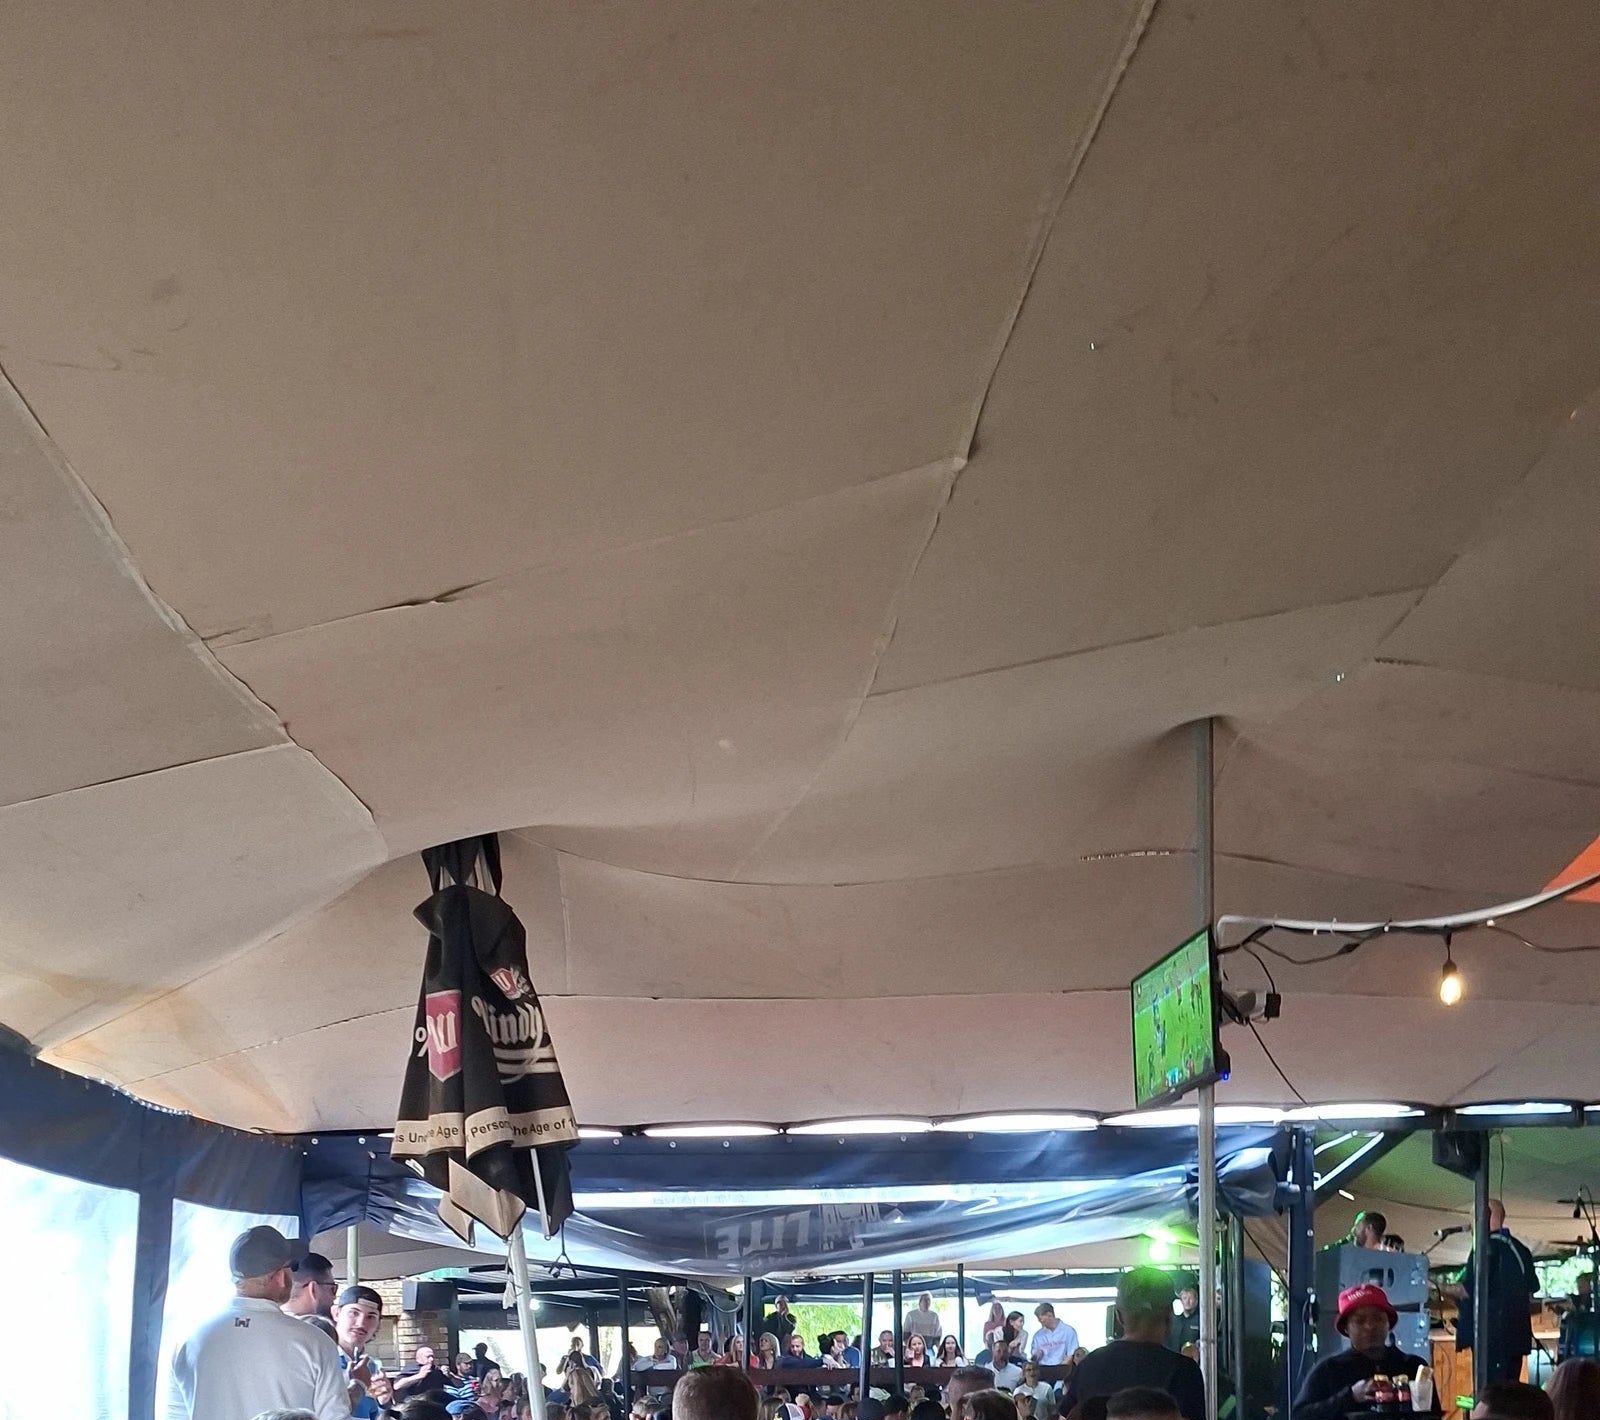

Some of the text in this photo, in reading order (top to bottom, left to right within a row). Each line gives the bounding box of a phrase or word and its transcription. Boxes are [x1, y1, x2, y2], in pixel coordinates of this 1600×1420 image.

[436, 1125, 459, 1141] Age
[529, 1119, 550, 1137] Age
[553, 1117, 568, 1131] of
